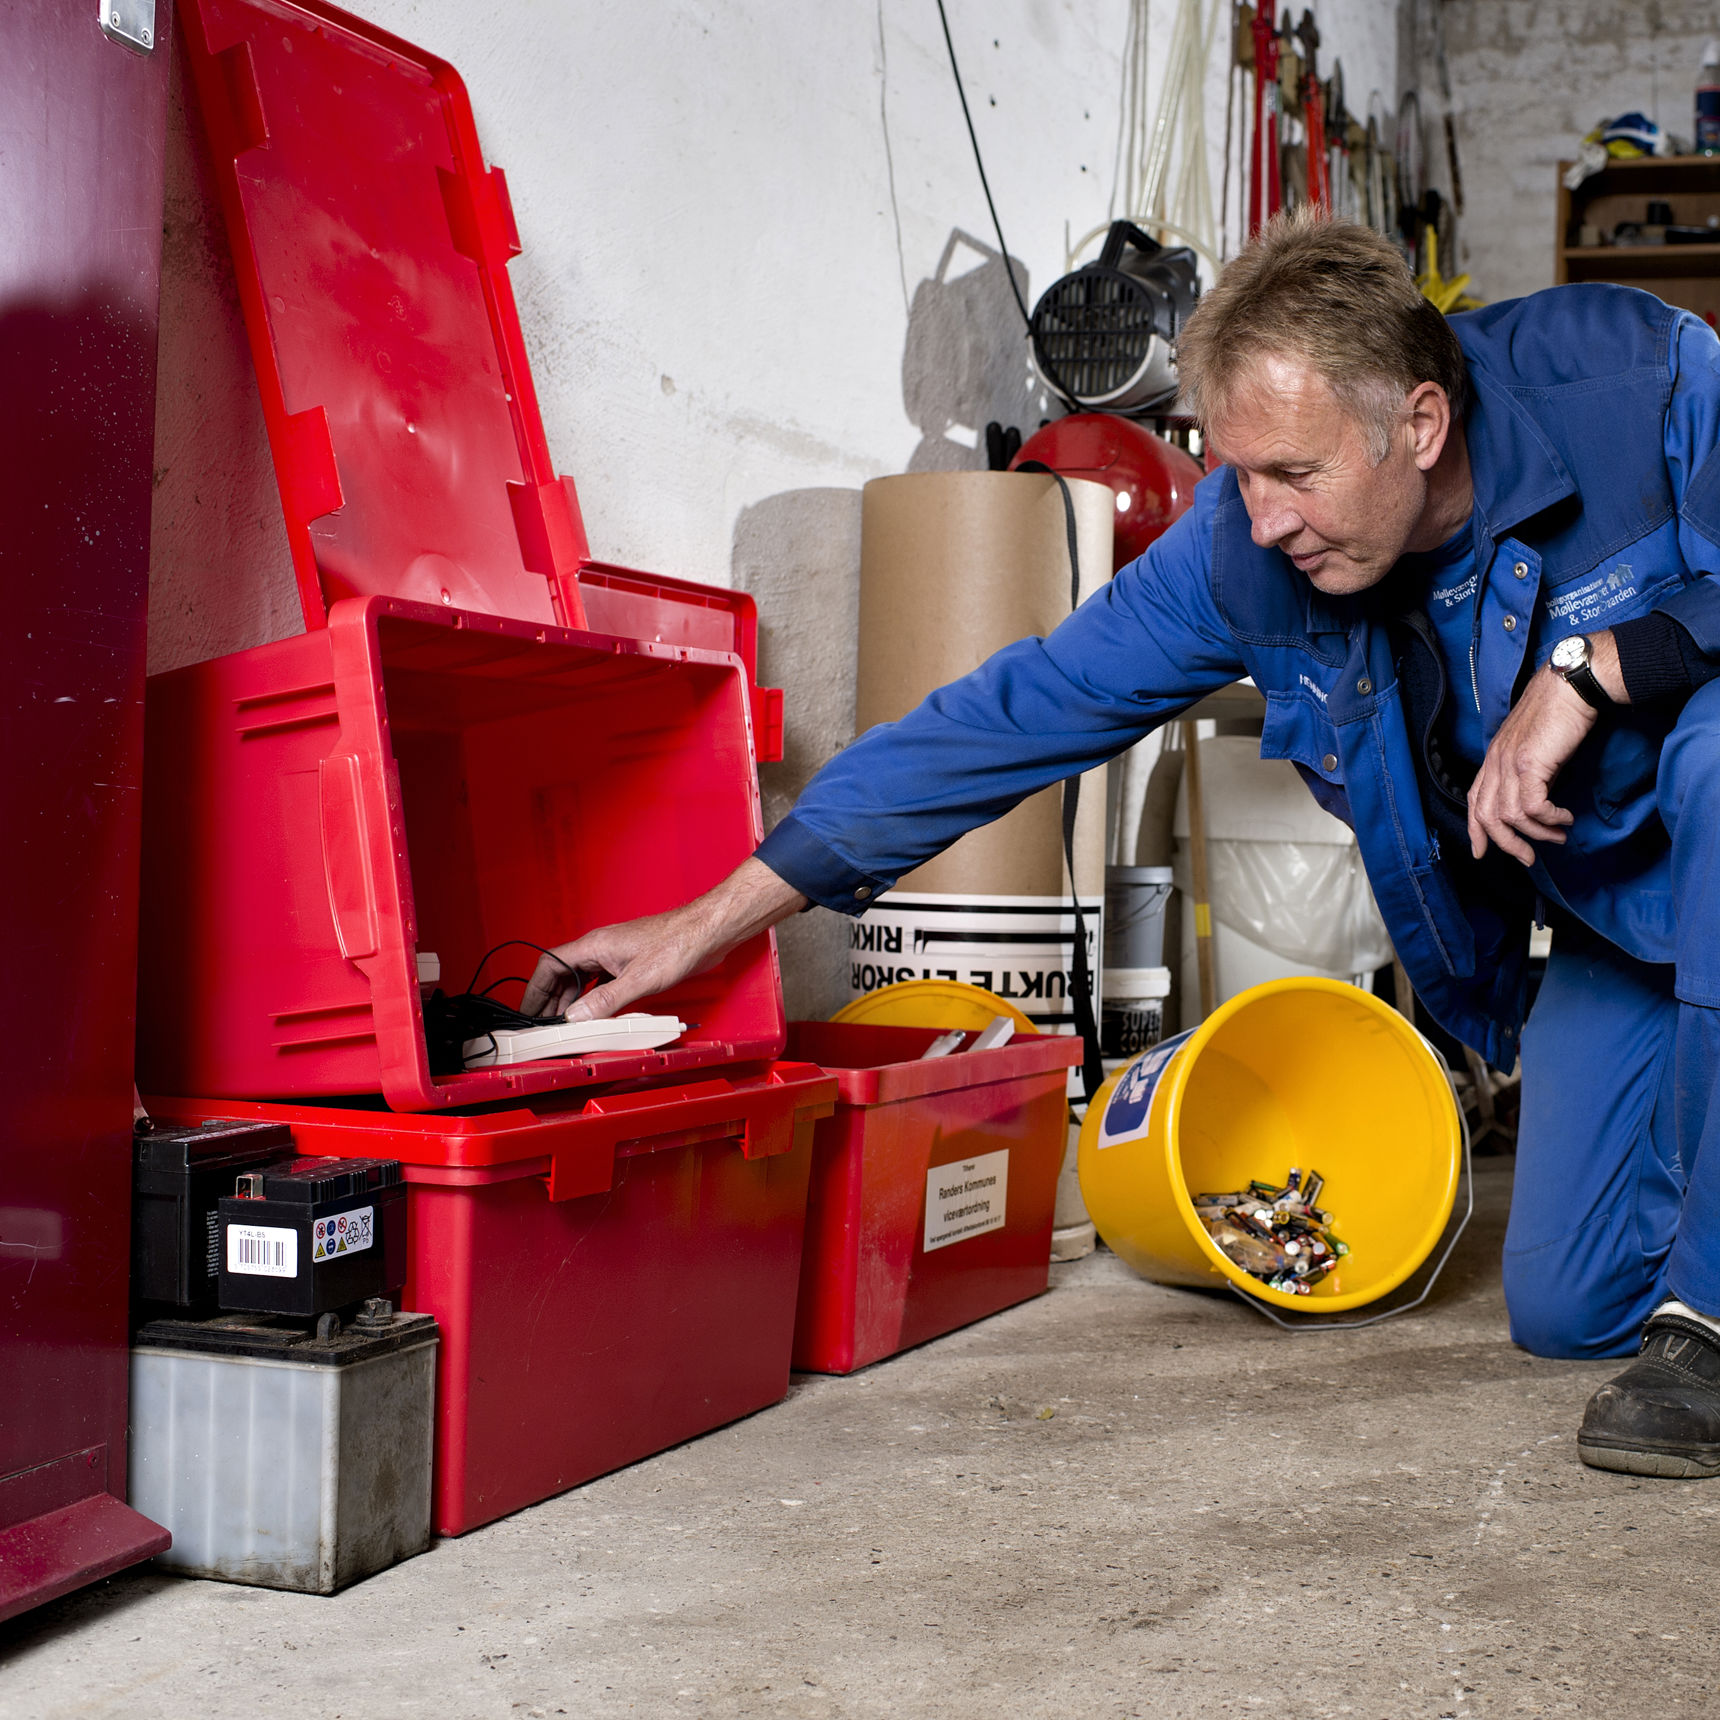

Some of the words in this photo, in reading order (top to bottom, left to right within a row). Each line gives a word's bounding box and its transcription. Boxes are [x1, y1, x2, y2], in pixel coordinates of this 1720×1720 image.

[1433, 574, 1478, 600] Møllevæng
[1569, 614, 1580, 626] &
[938, 1184, 963, 1200] Randers
[964, 1175, 997, 1192] Kommunes
